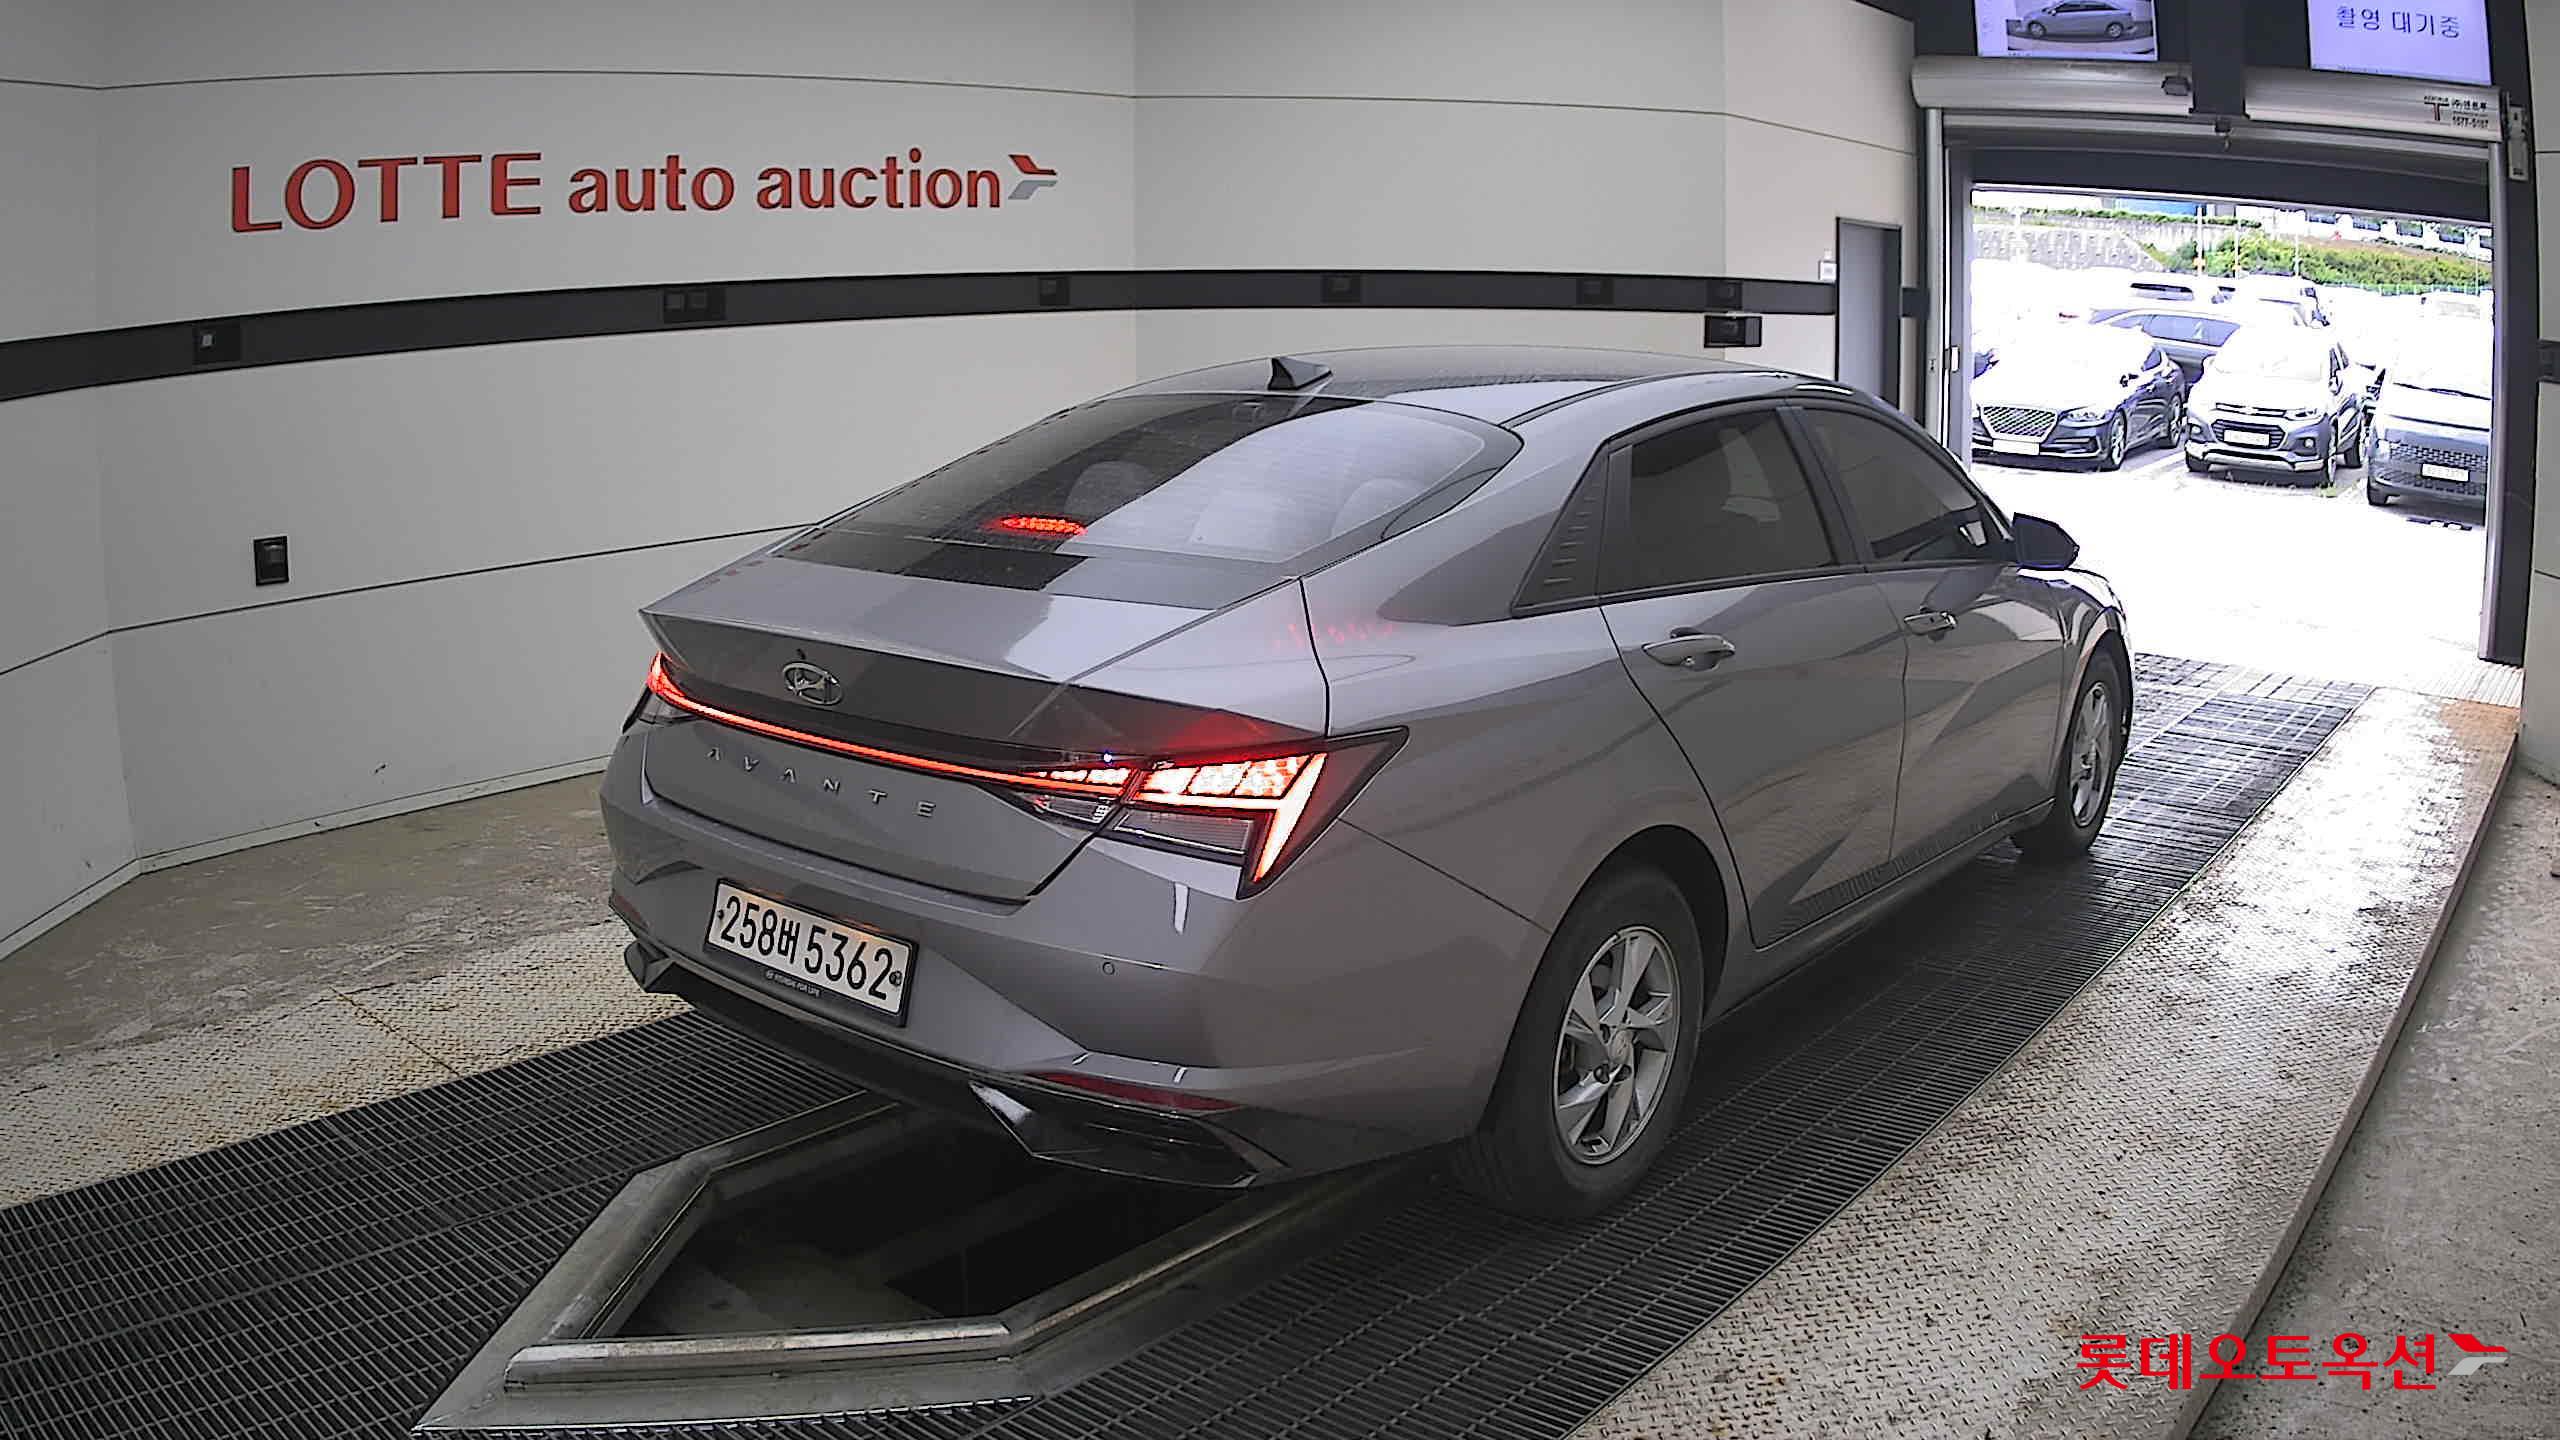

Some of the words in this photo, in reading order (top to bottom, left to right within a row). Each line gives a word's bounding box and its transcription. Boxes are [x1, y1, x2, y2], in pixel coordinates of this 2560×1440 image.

[2337, 6, 2380, 31] 촬영
[2391, 11, 2460, 39] 대기중
[232, 152, 542, 233] LOTTE
[569, 155, 736, 213] auto
[758, 148, 1002, 209] auction
[706, 746, 937, 818] AVANTE
[804, 924, 894, 1001] 5362
